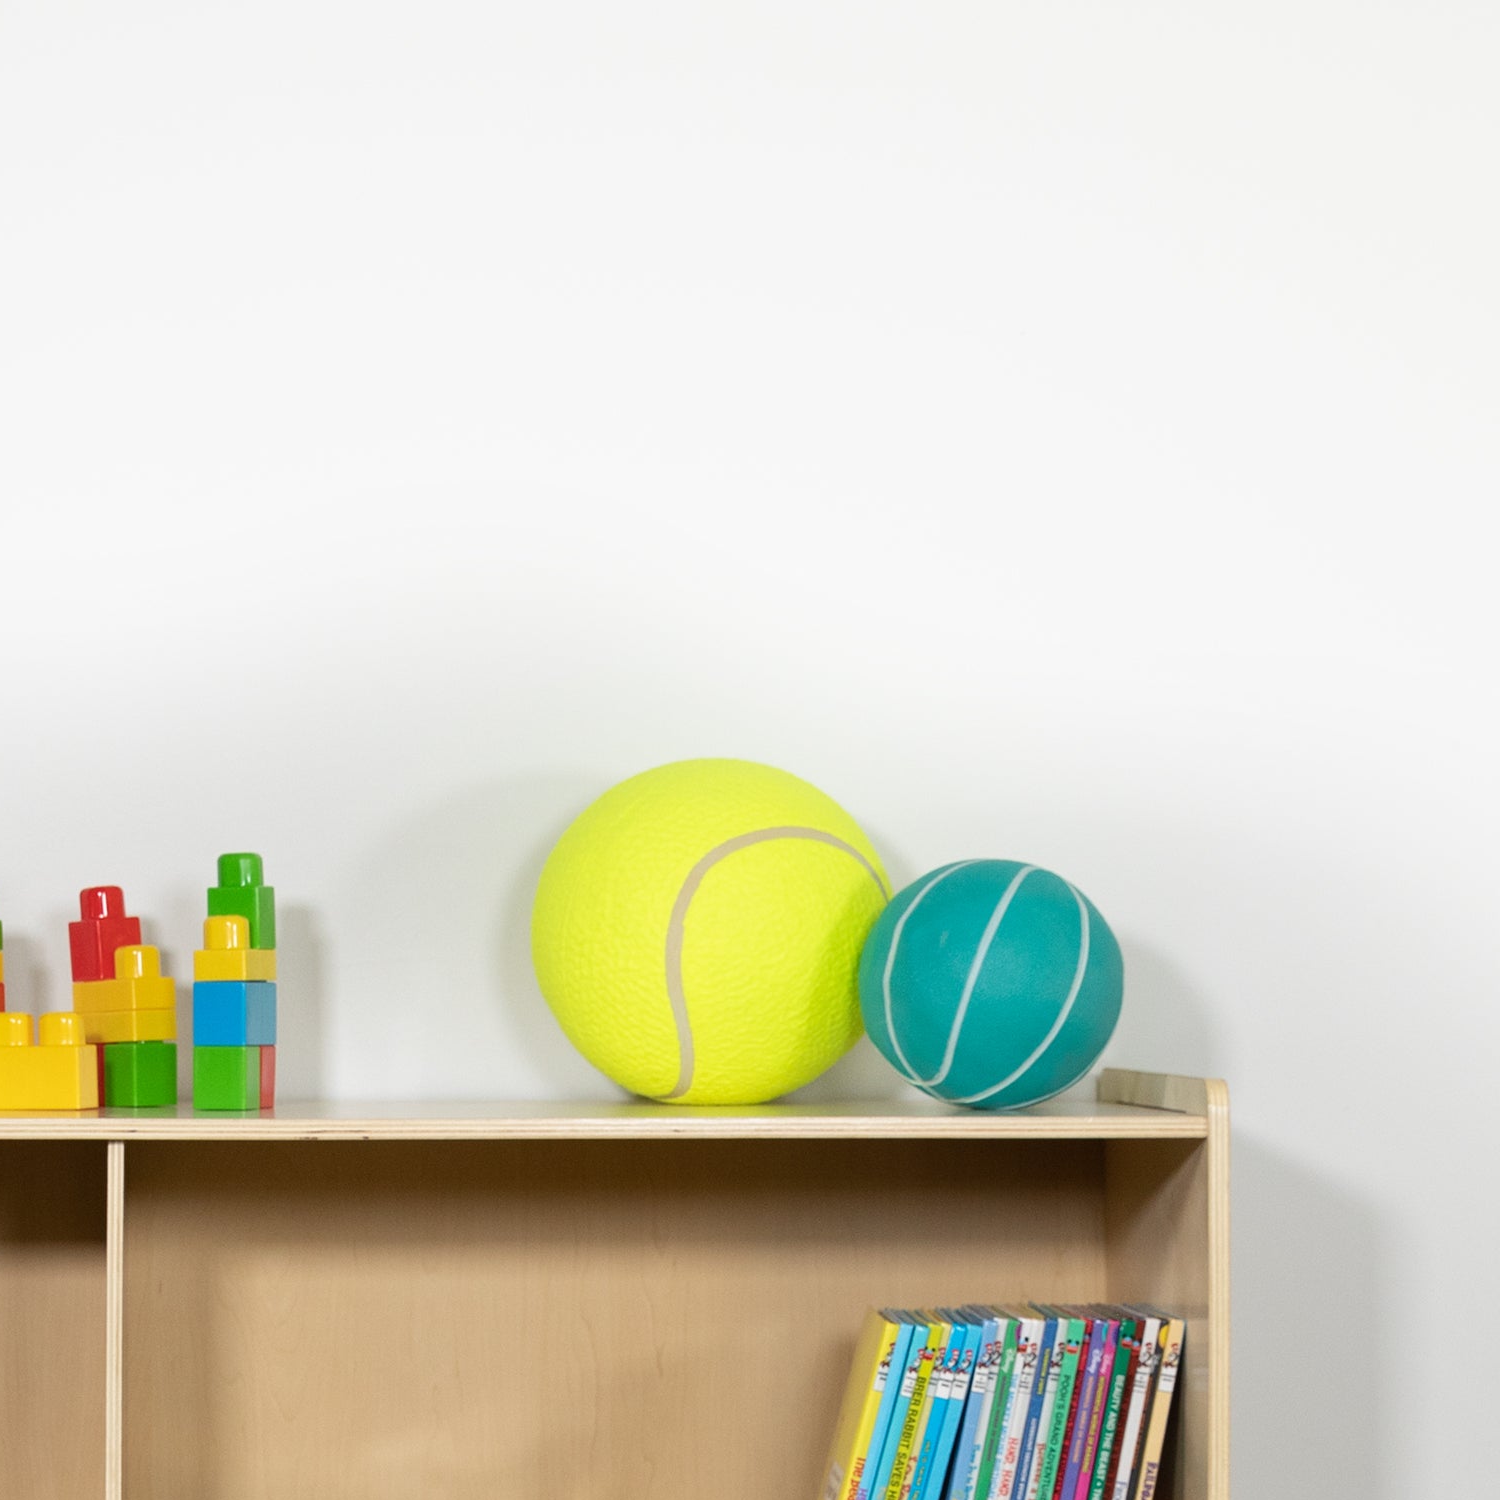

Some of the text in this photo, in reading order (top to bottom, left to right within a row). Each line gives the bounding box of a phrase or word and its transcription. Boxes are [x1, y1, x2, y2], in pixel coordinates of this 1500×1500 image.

[1085, 1347, 1102, 1375] Disney
[909, 1375, 927, 1407] BRER
[1056, 1374, 1069, 1410] POOH'S
[1109, 1373, 1125, 1410] BEAUTY
[898, 1407, 918, 1449] RABBIT
[1049, 1411, 1063, 1445] GRAND
[1104, 1410, 1118, 1431] AND
[1003, 1436, 1018, 1466] HAND,
[1100, 1431, 1113, 1450] THE
[888, 1450, 907, 1488] SAVES
[1094, 1450, 1110, 1480] BEAST
[996, 1468, 1012, 1498] HAND,
